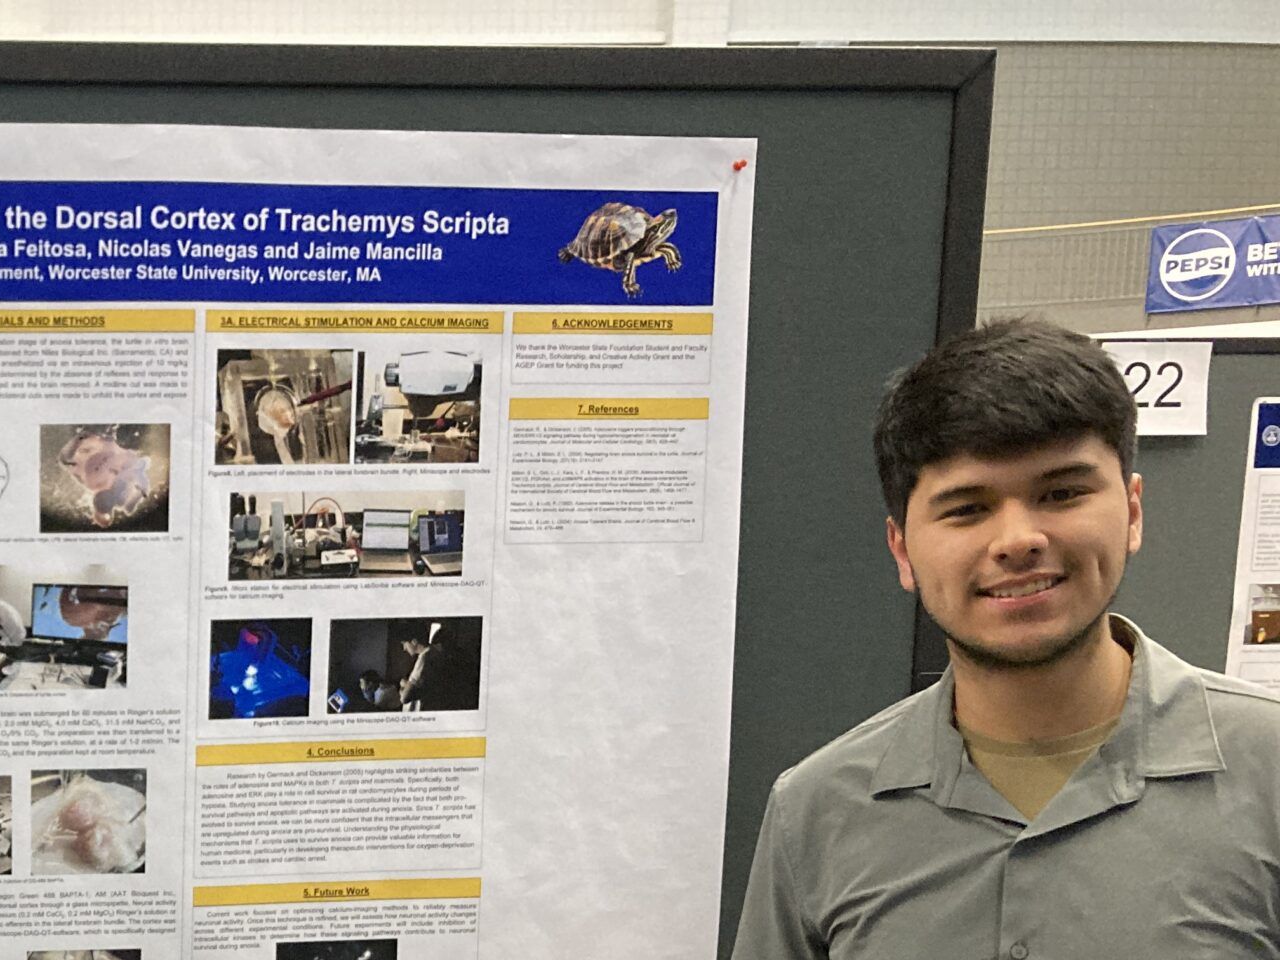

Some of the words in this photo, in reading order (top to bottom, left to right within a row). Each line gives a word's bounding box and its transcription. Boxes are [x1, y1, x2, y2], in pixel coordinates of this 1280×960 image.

[4, 206, 48, 233] the
[54, 206, 143, 234] Dorsal
[148, 207, 236, 235] Cortex
[242, 208, 269, 235] of
[274, 208, 416, 242] Trachemys
[421, 210, 510, 243] Scripta
[13, 238, 92, 265] Feitosa,
[97, 239, 171, 261] Nicolas
[175, 239, 258, 266] Vanegas
[262, 240, 299, 262] and
[303, 240, 361, 262] Jaime
[365, 241, 443, 263] Mancilla
[1247, 241, 1280, 262] BE
[1165, 255, 1230, 274] PEPSI
[1246, 262, 1280, 277] WIT
[47, 264, 131, 282] Worcester
[135, 264, 177, 282] State
[181, 264, 264, 286] University,
[267, 265, 351, 286] Worcester,
[355, 265, 382, 283] MA
[26, 316, 50, 327] AND
[52, 316, 105, 327] METHODS
[238, 316, 302, 328] ELECTRICAL
[304, 317, 372, 328] STIMULATION
[375, 317, 397, 328] AND
[399, 317, 444, 328] CALCIUM
[447, 317, 489, 328] IMAGING
[552, 319, 559, 329] 6.
[562, 319, 673, 329] ACKNOWLEDGEMENTS
[1124, 361, 1183, 408] 22
[578, 404, 585, 415] 7.
[588, 404, 639, 415] References
[306, 747, 314, 757] 4.
[317, 745, 375, 757] Conclusions
[303, 887, 311, 898] 5.
[313, 886, 343, 897] Future
[345, 885, 369, 897] Work
